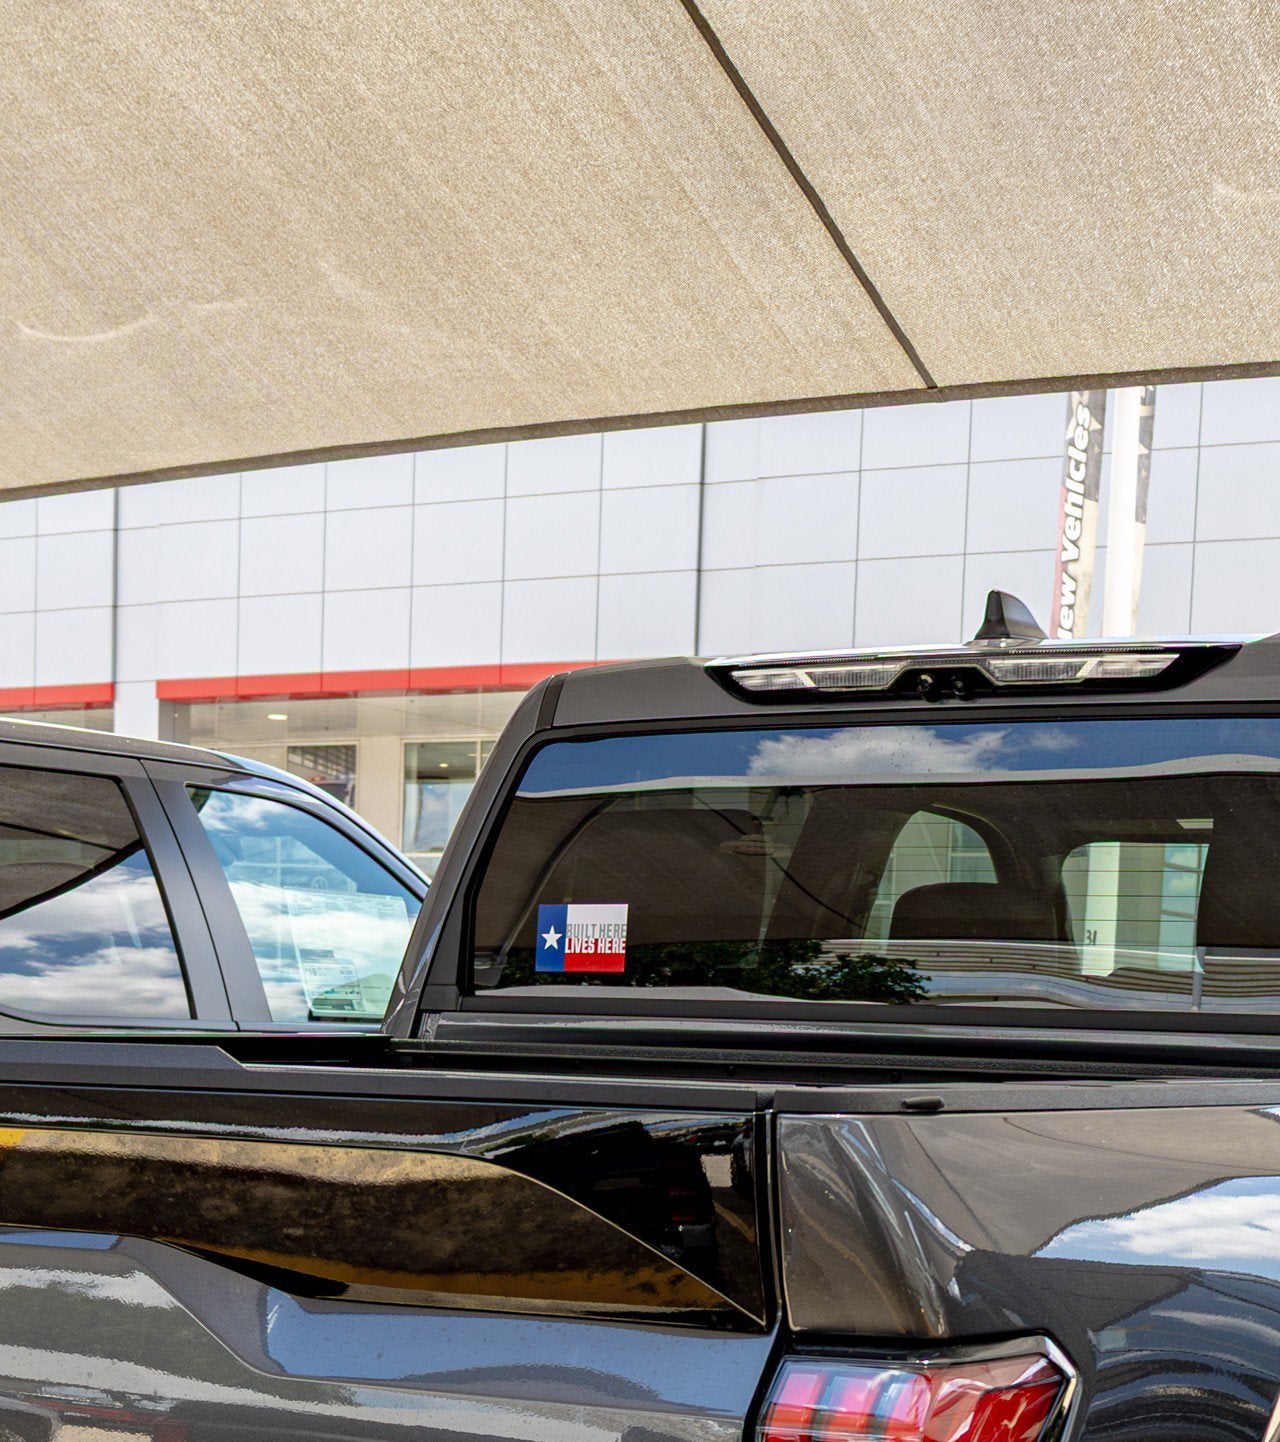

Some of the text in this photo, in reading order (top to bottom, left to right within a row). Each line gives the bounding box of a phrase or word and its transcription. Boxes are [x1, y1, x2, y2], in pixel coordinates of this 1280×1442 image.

[1061, 404, 1092, 563] Vehicles
[565, 923, 627, 938] BUILT HERE
[564, 938, 626, 954] LIVES HERE
